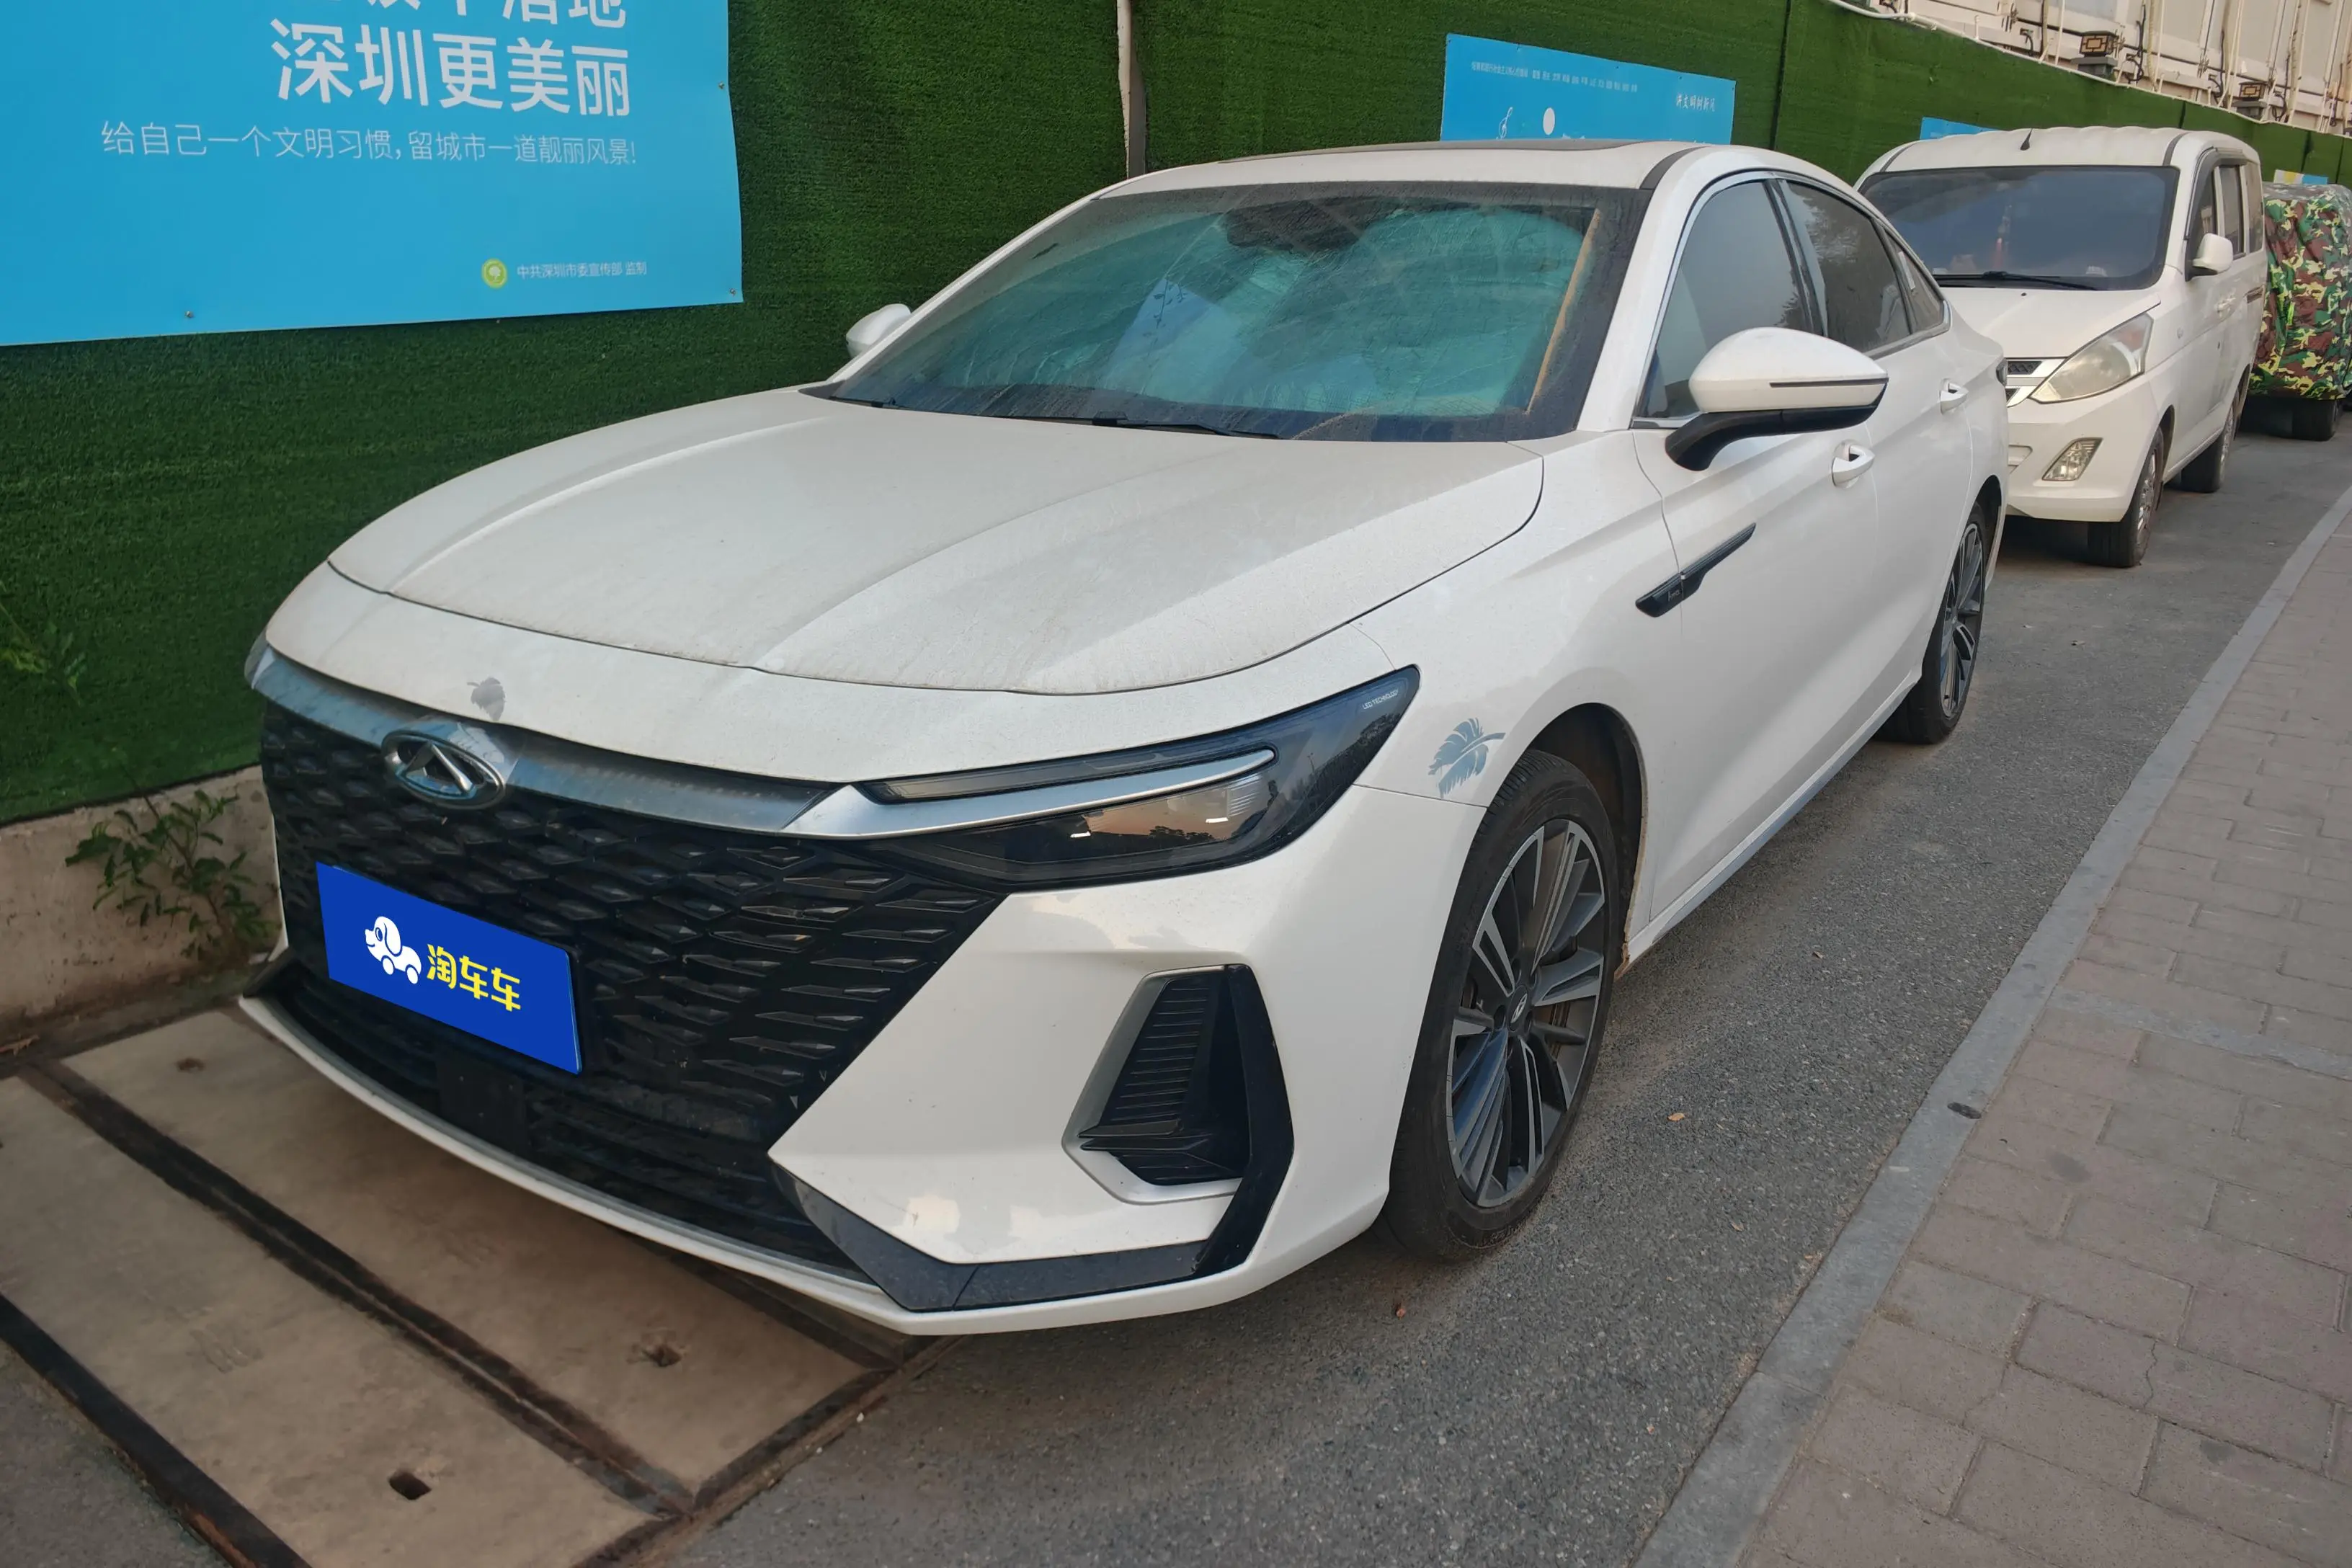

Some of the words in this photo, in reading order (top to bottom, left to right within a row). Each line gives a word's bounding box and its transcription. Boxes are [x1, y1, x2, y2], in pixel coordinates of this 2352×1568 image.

[270, 18, 631, 116] 深圳更美丽
